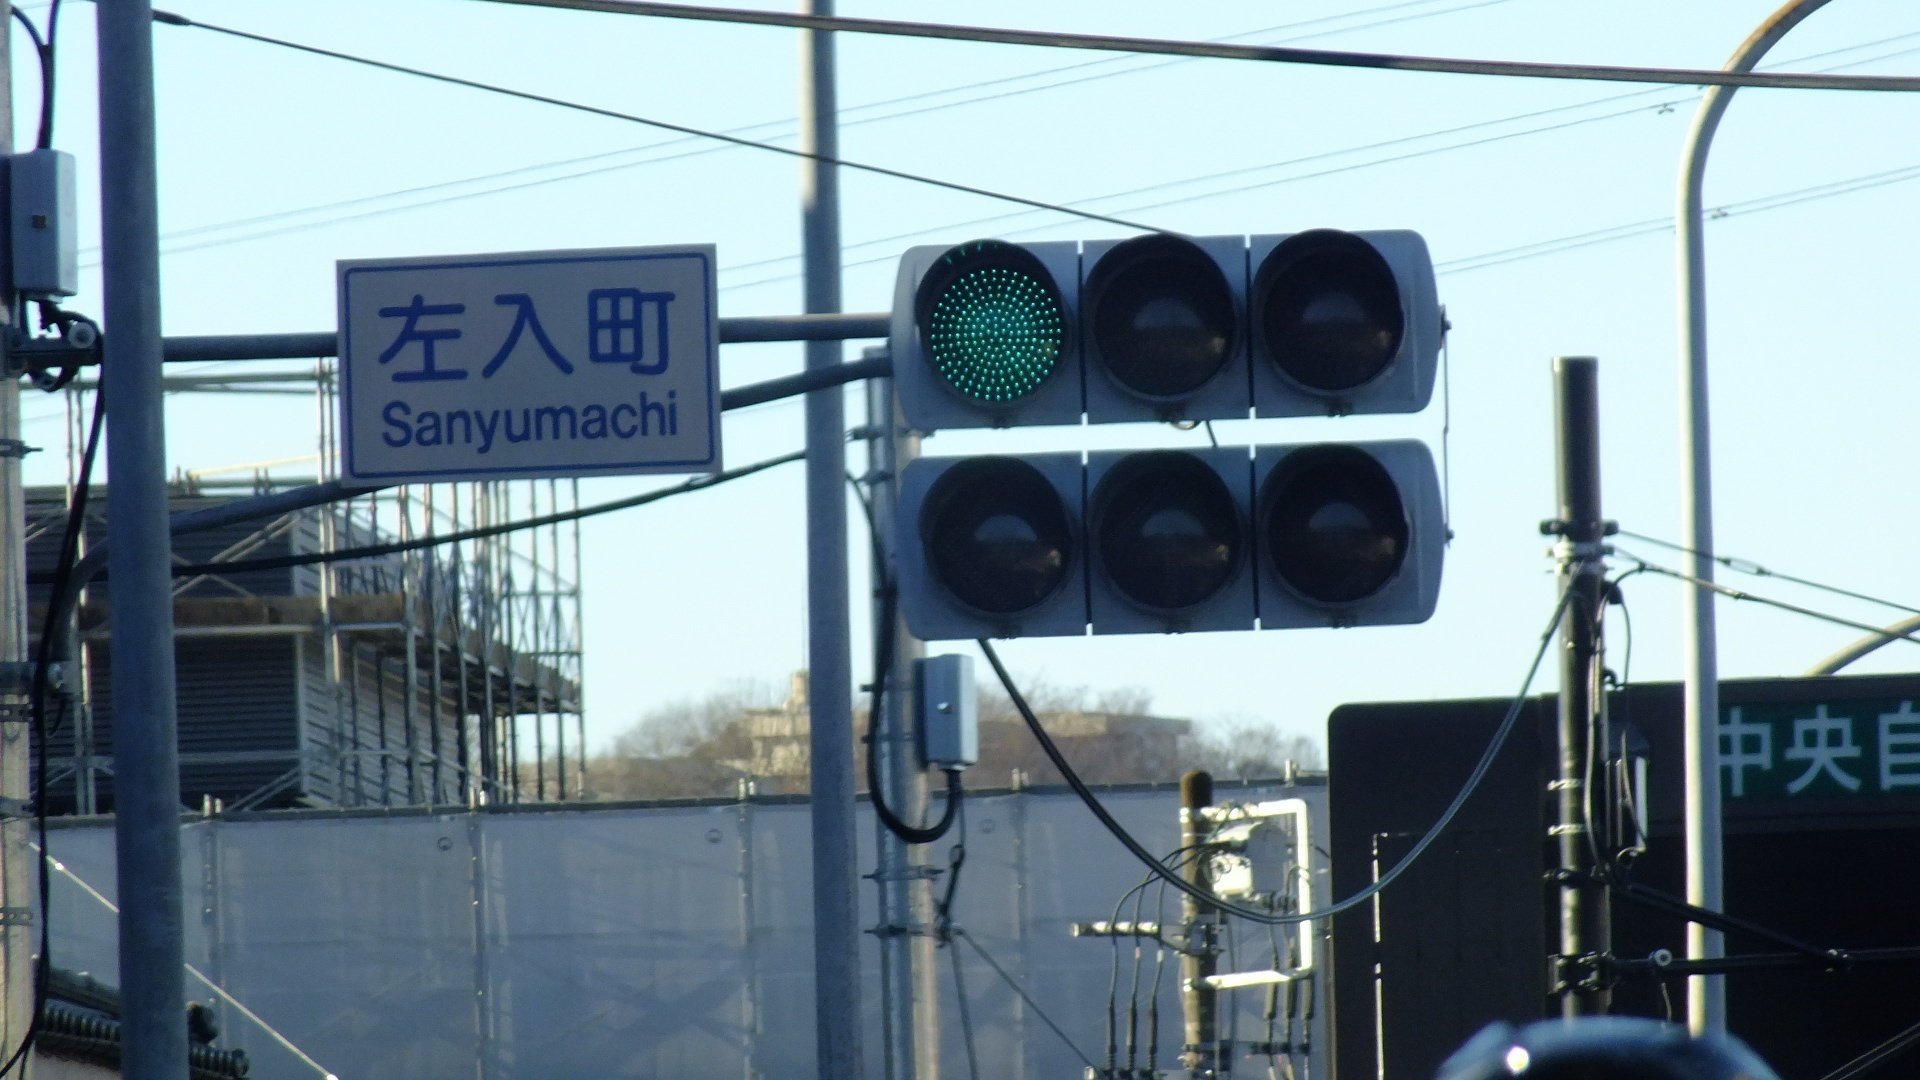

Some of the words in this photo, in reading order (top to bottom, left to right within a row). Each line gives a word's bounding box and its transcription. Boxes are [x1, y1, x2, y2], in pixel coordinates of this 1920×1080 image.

[378, 287, 676, 383] 左入町
[382, 389, 677, 454] Sanyumachi
